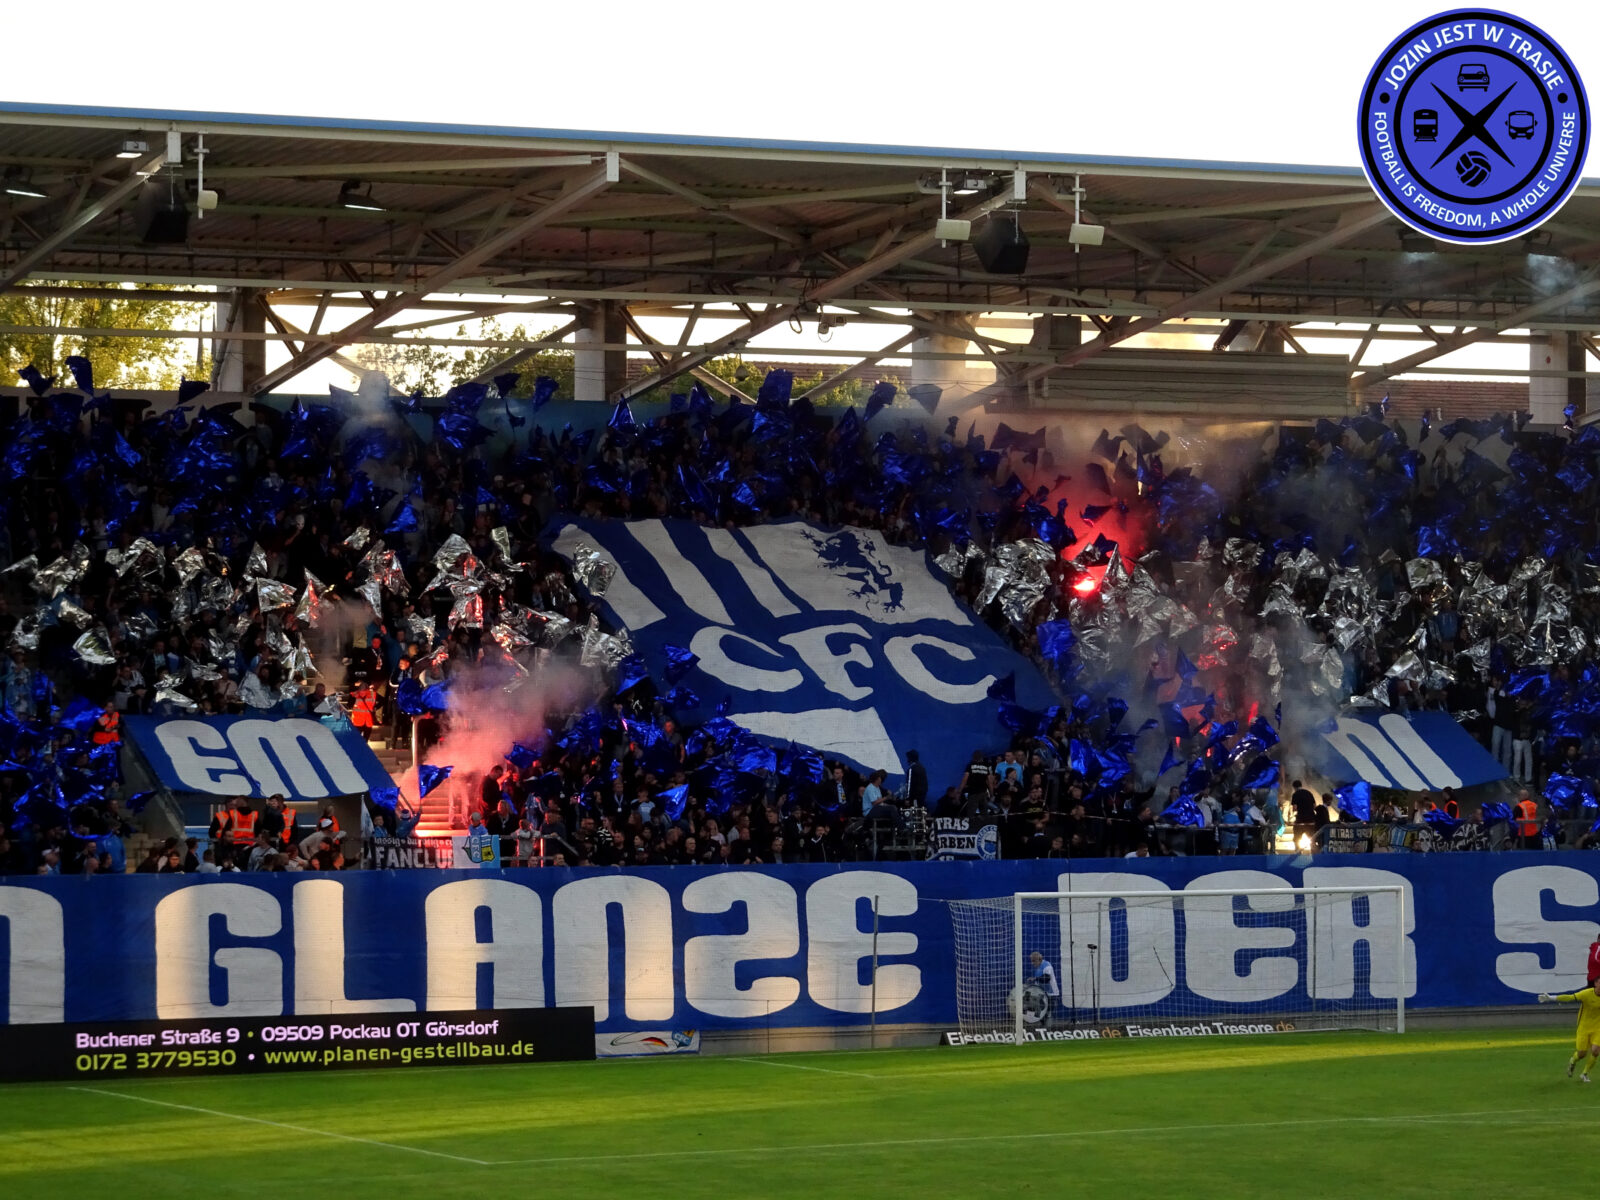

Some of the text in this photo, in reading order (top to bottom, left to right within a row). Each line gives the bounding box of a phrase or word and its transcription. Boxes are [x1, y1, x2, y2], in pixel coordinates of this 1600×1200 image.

[691, 622, 996, 704] CFC
[154, 718, 370, 798] EM
[935, 817, 970, 831] TRAS
[155, 870, 922, 1021] GLANZE
[1058, 867, 1417, 1008] DER
[76, 1020, 499, 1048] Buchener Straße 9 09509 Pockau OT Görsdorf
[946, 1029, 1035, 1046] Eisenbah
[1126, 1022, 1213, 1037] Eisenbach
[76, 1040, 534, 1071] 0172 3779530 www.planen-gestellbau.de
